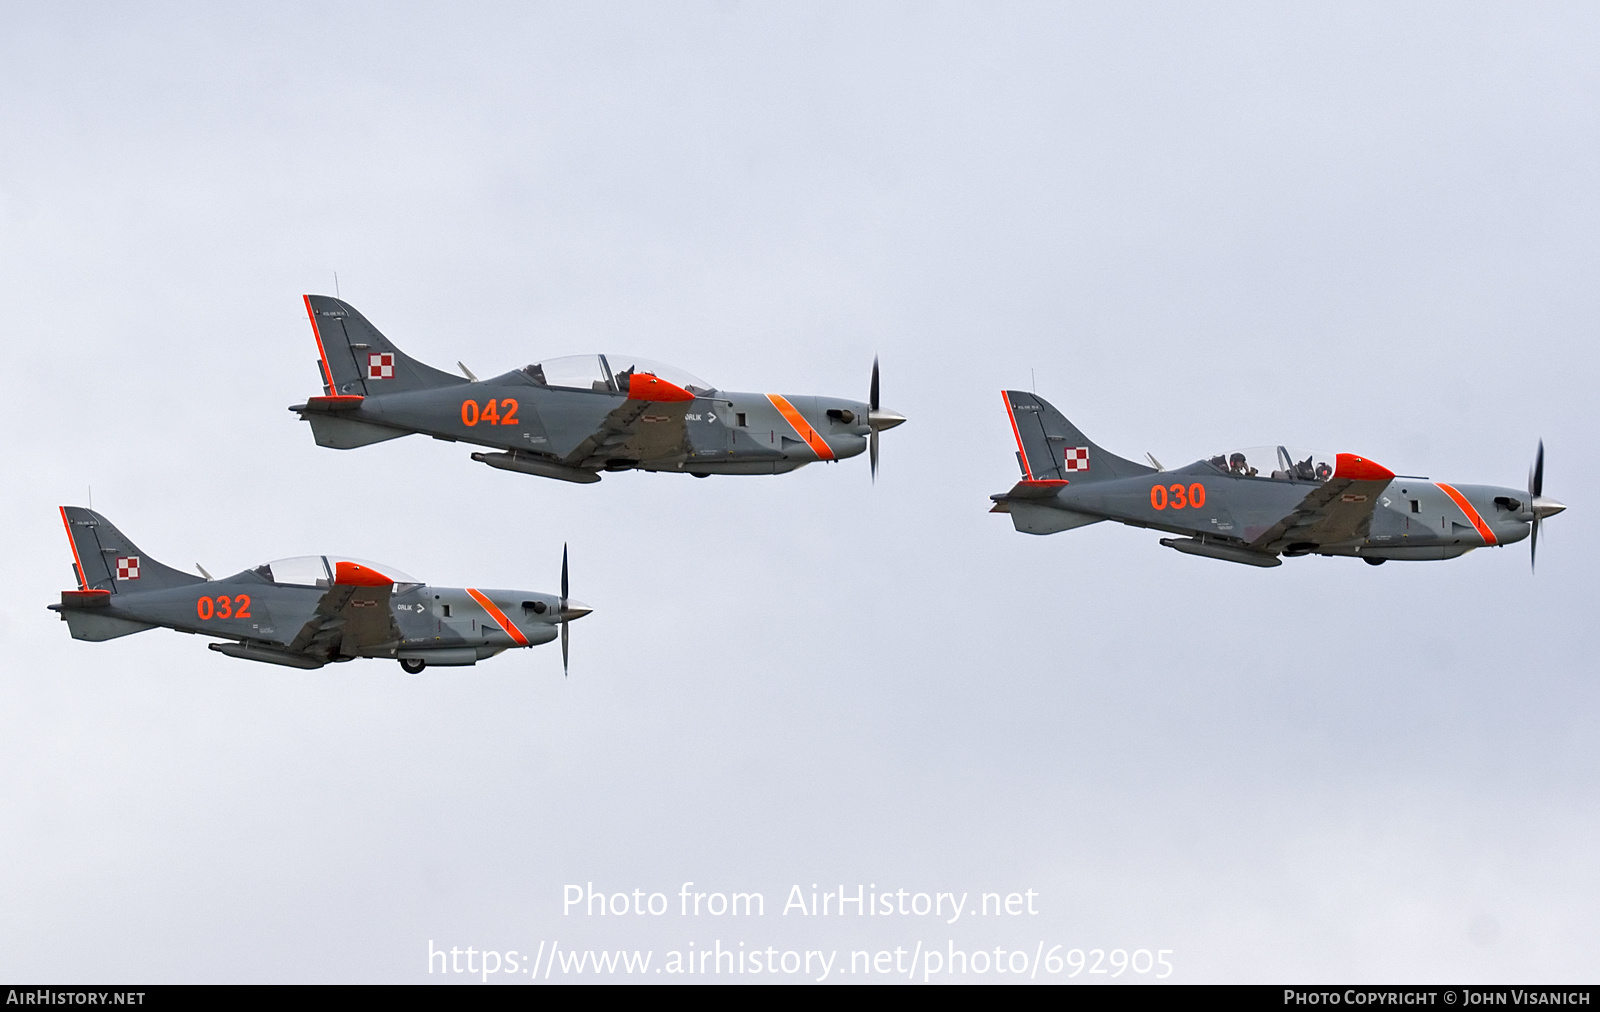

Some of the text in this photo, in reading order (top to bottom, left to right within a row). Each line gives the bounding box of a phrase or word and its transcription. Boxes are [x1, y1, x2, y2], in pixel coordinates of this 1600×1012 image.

[461, 398, 519, 427] 042
[684, 413, 702, 421] ORLIK
[1150, 482, 1206, 511] 030
[197, 593, 251, 620] 032
[397, 603, 413, 611] ORLIK
